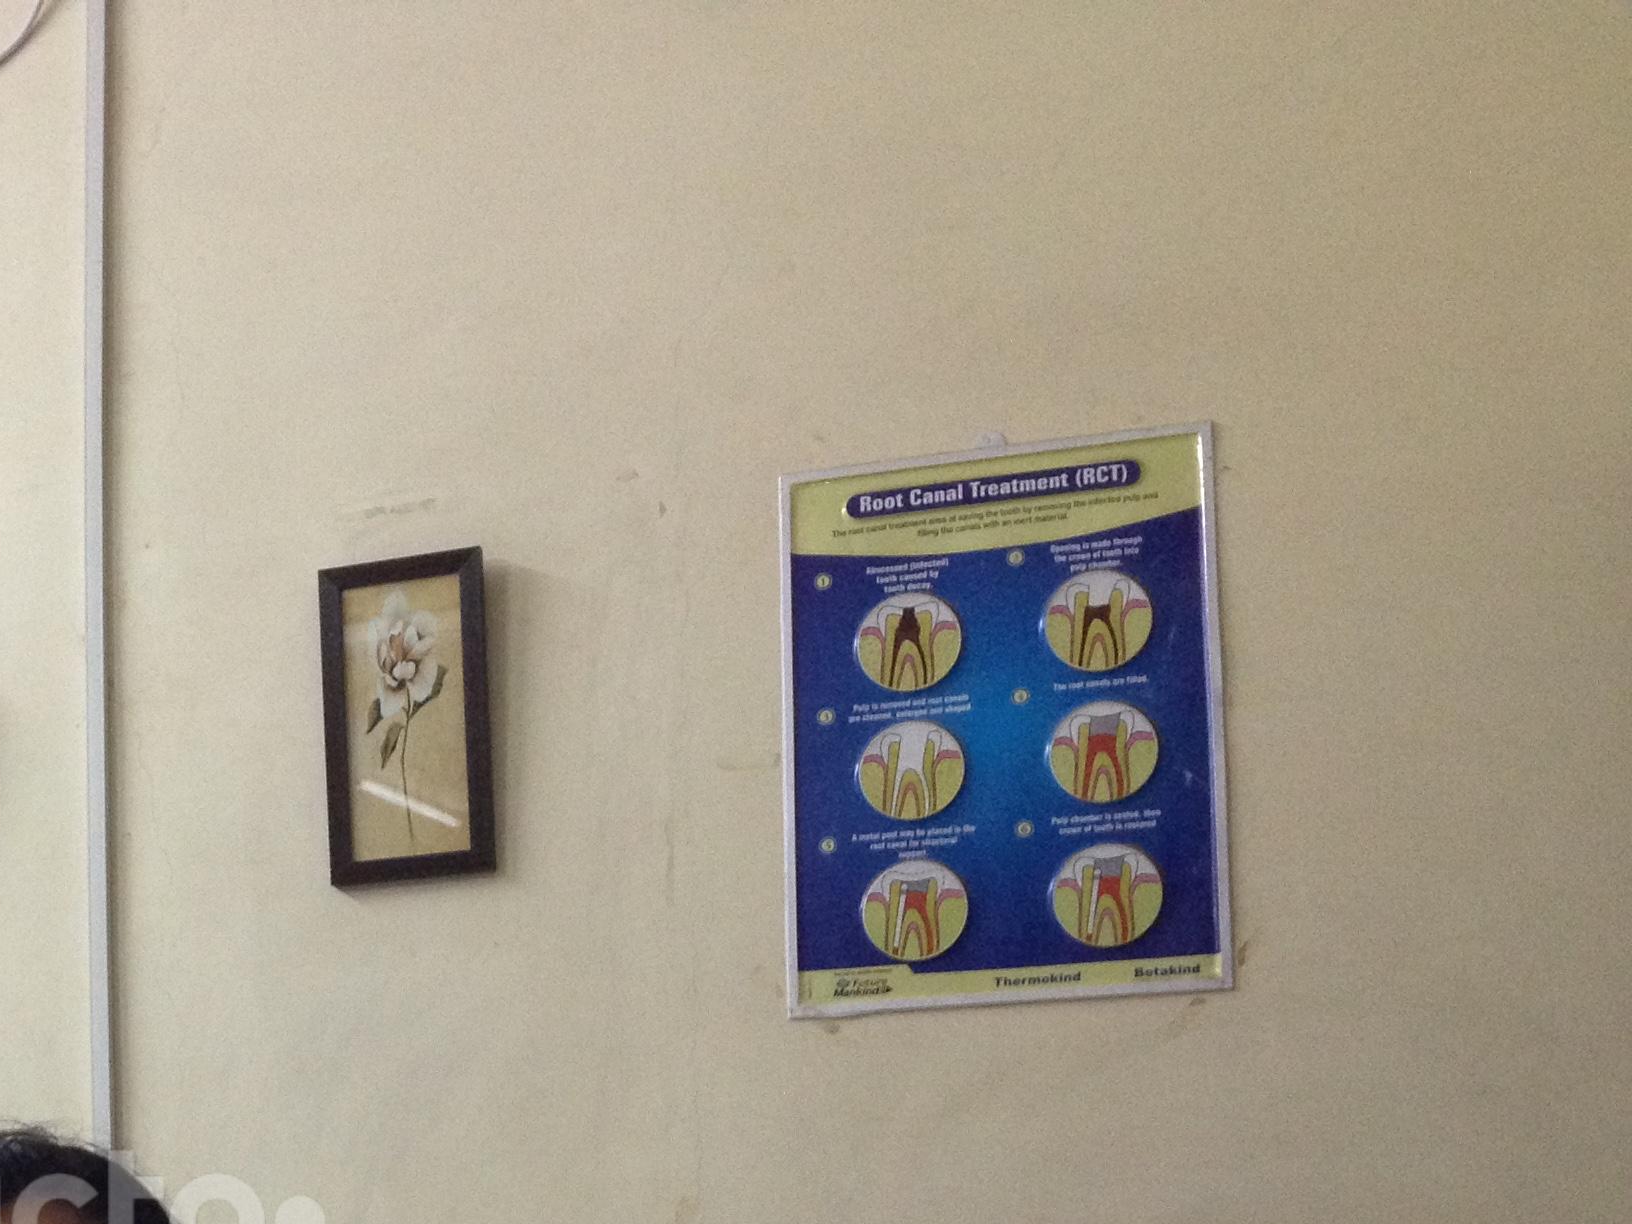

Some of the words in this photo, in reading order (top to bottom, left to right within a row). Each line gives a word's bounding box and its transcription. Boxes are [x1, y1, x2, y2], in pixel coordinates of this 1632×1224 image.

[859, 494, 904, 513] Root
[910, 483, 963, 505] Canal
[969, 473, 1069, 498] Treatment
[1075, 463, 1128, 487] (RCT)
[994, 971, 1081, 988] Thermokind
